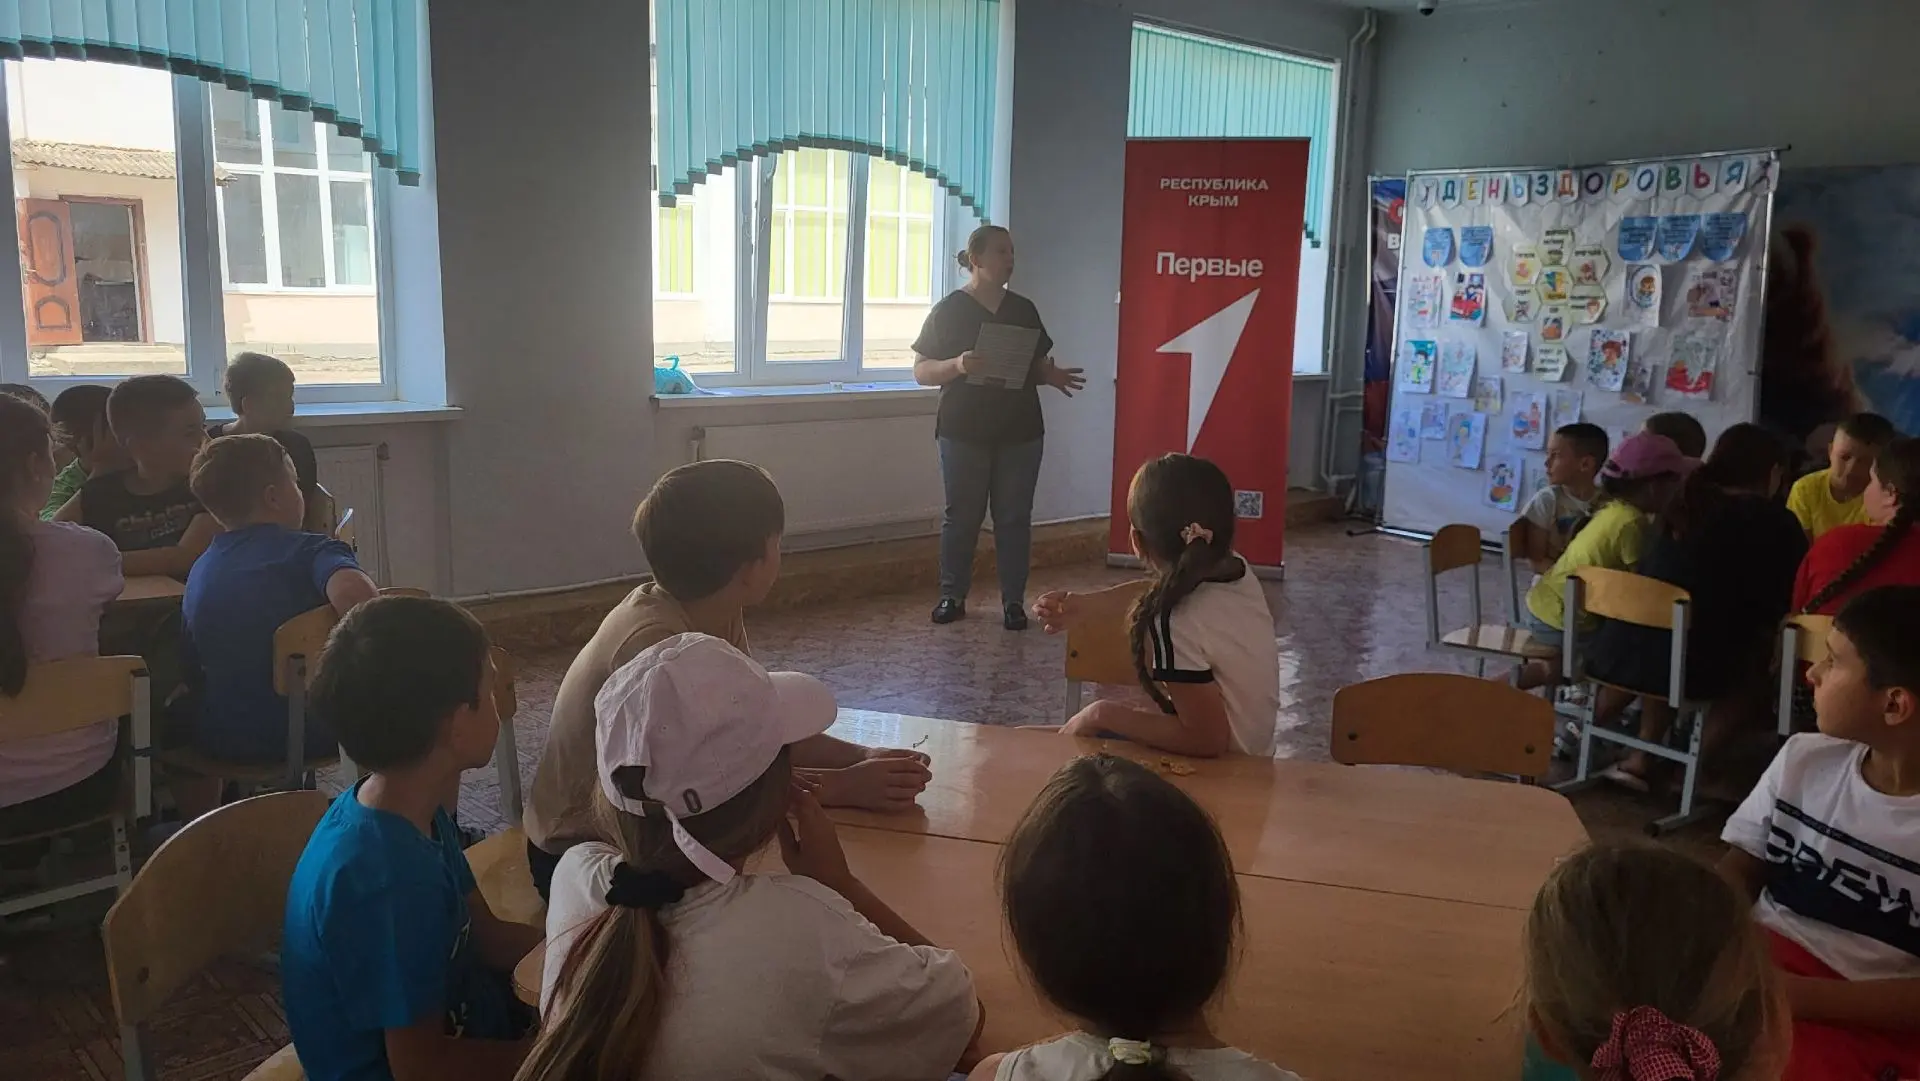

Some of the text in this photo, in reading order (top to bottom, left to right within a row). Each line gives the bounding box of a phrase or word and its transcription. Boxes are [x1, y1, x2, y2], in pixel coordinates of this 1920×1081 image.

[1159, 177, 1270, 191] РЕСПУБЛИКА
[1187, 194, 1239, 207] КРЫМ
[1156, 251, 1264, 283] Первые
